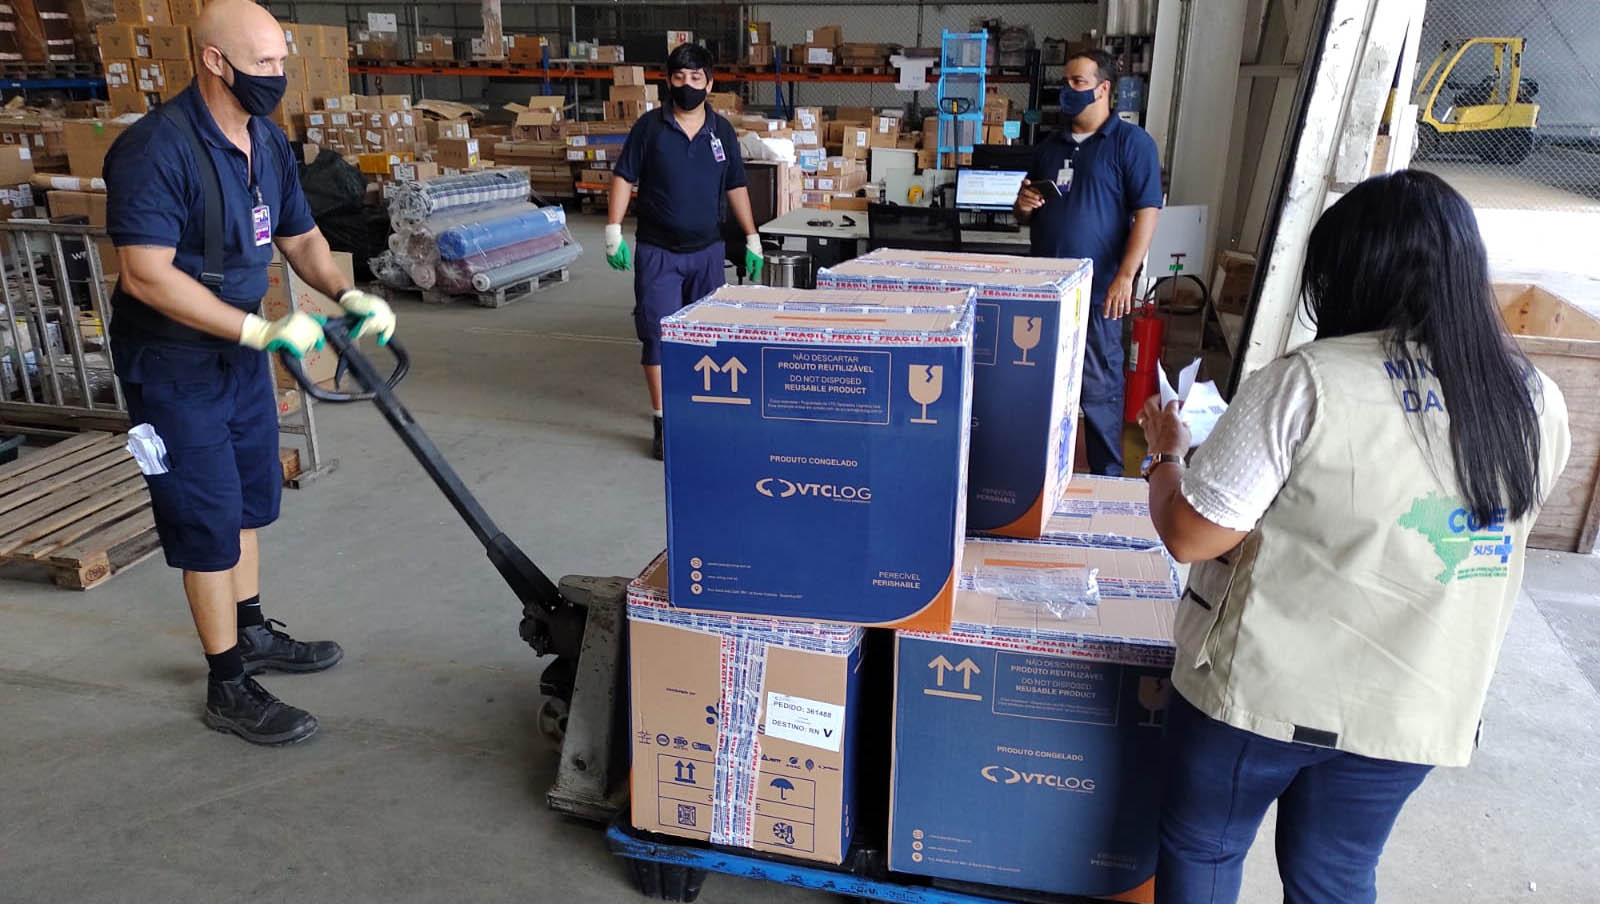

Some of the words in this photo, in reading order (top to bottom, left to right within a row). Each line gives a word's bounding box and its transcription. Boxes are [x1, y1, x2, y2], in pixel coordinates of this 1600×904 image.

[792, 352, 810, 361] NÃO
[812, 354, 859, 362] DESCARTAR
[778, 362, 816, 370] PRODUTO
[818, 362, 874, 373] REUTILIZÁVEL
[790, 374, 802, 382] DO
[804, 375, 820, 383] NOT
[822, 376, 862, 385] DISPOSED
[784, 384, 827, 392] REUSABLE
[828, 386, 867, 394] PRODUCT
[770, 454, 808, 464] PRODUTO
[808, 457, 858, 468] CONGELADO
[796, 482, 872, 500] VTCLOG
[1474, 544, 1494, 556] SUS
[879, 570, 920, 581] PERECÍVEL
[872, 579, 920, 590] PERISHABLE
[1010, 665, 1048, 675] PRODUTO
[1016, 685, 1057, 695] REUSABLE
[1059, 688, 1096, 698] PRODUCT
[773, 701, 804, 712] PEDIDO:
[772, 719, 807, 732] DESTINO:
[823, 728, 833, 737] V
[996, 745, 1034, 757] PRODUTO
[1035, 749, 1084, 761] CONGELADO
[1021, 772, 1096, 791] VTCLOG
